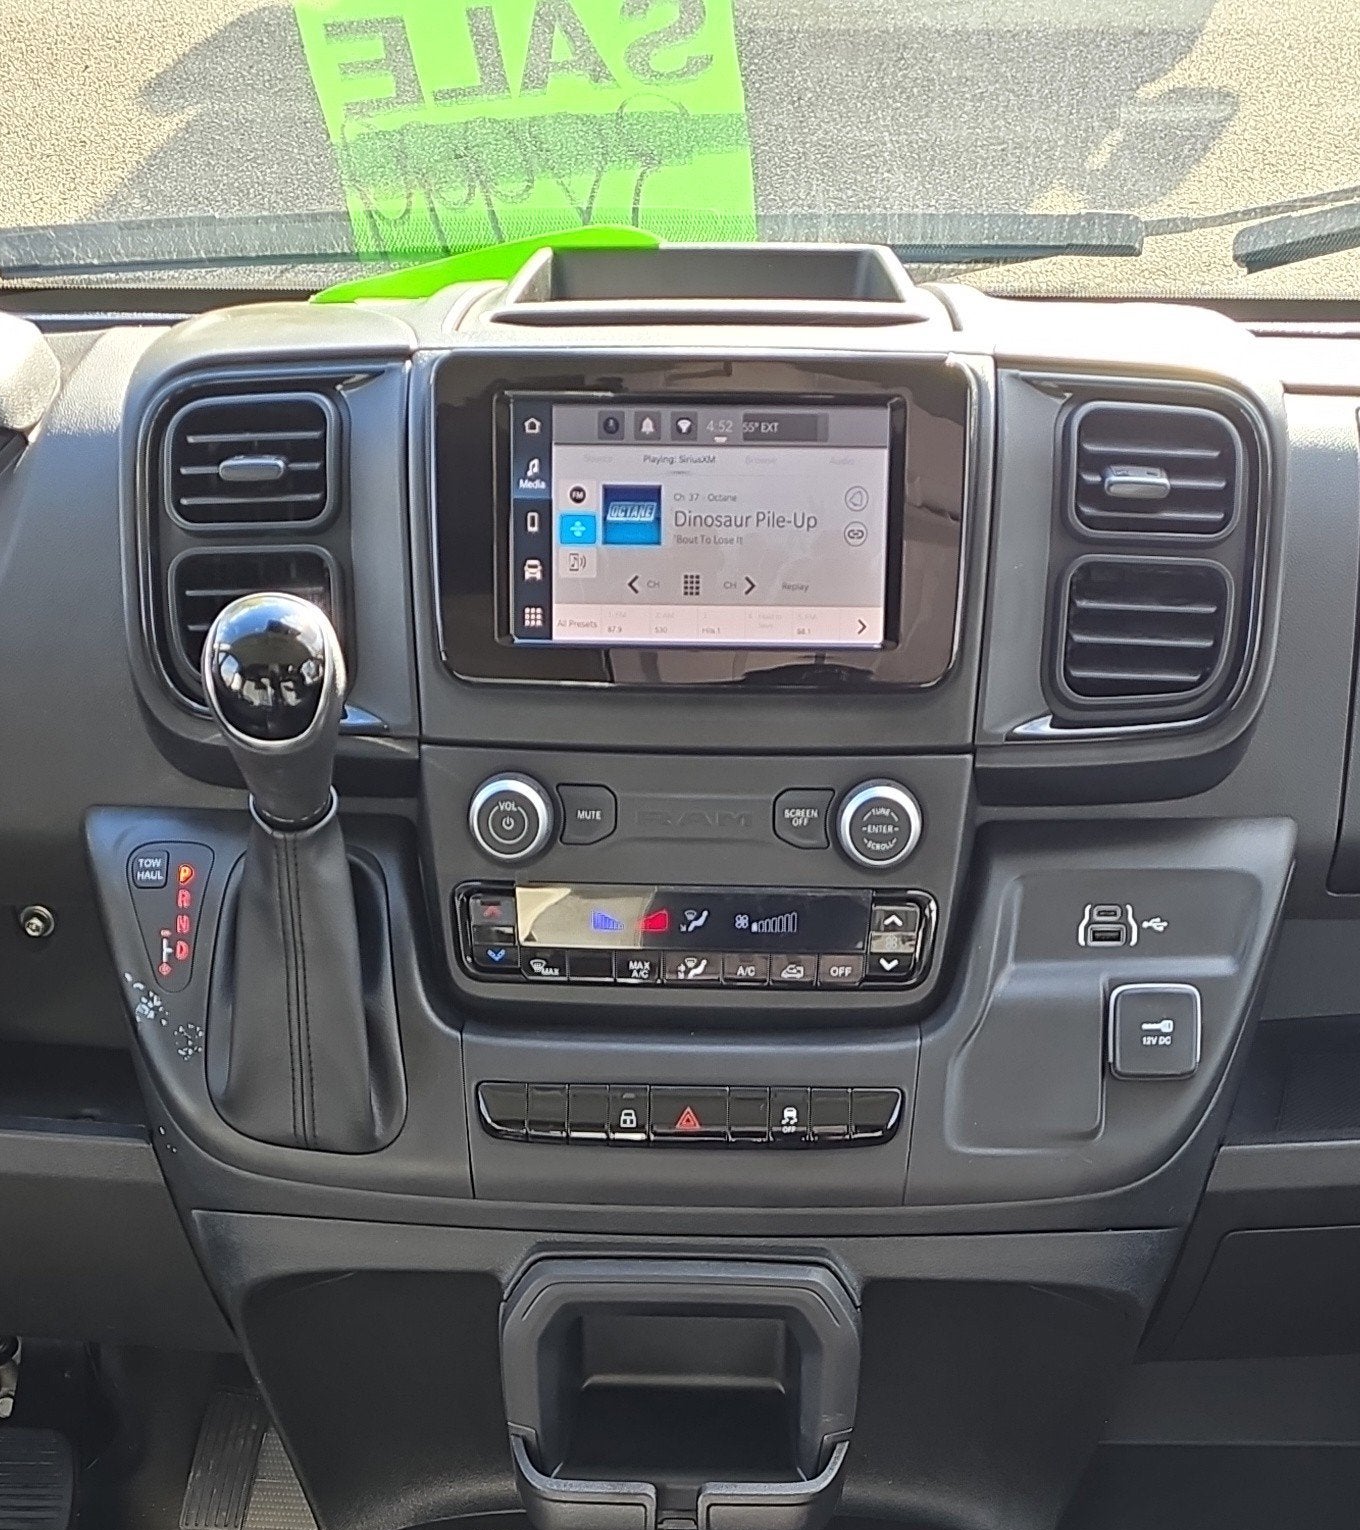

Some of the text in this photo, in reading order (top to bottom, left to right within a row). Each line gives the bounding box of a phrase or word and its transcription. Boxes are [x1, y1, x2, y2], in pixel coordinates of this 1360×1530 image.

[761, 422, 779, 432] EXT
[519, 479, 546, 490] Media
[609, 503, 655, 519] OCTANE
[674, 510, 818, 531] Dinosaur Pile-Up
[700, 535, 712, 545] To
[714, 536, 735, 545] Lose
[498, 801, 517, 811] VOL
[577, 809, 601, 820] MUTE
[784, 809, 819, 818] SCREEN
[792, 817, 809, 827] OFF
[867, 824, 894, 834] ENTER
[138, 858, 161, 868] TOW
[137, 870, 164, 880] HAUL
[179, 865, 193, 884] P
[177, 889, 191, 909] R
[176, 915, 190, 934] N
[175, 940, 189, 961] D
[629, 960, 651, 971] MAX
[541, 967, 559, 976] MAX
[631, 970, 649, 979] A/C
[737, 965, 756, 977] A/C
[830, 966, 852, 977] OFF
[1158, 1036, 1172, 1046] DC
